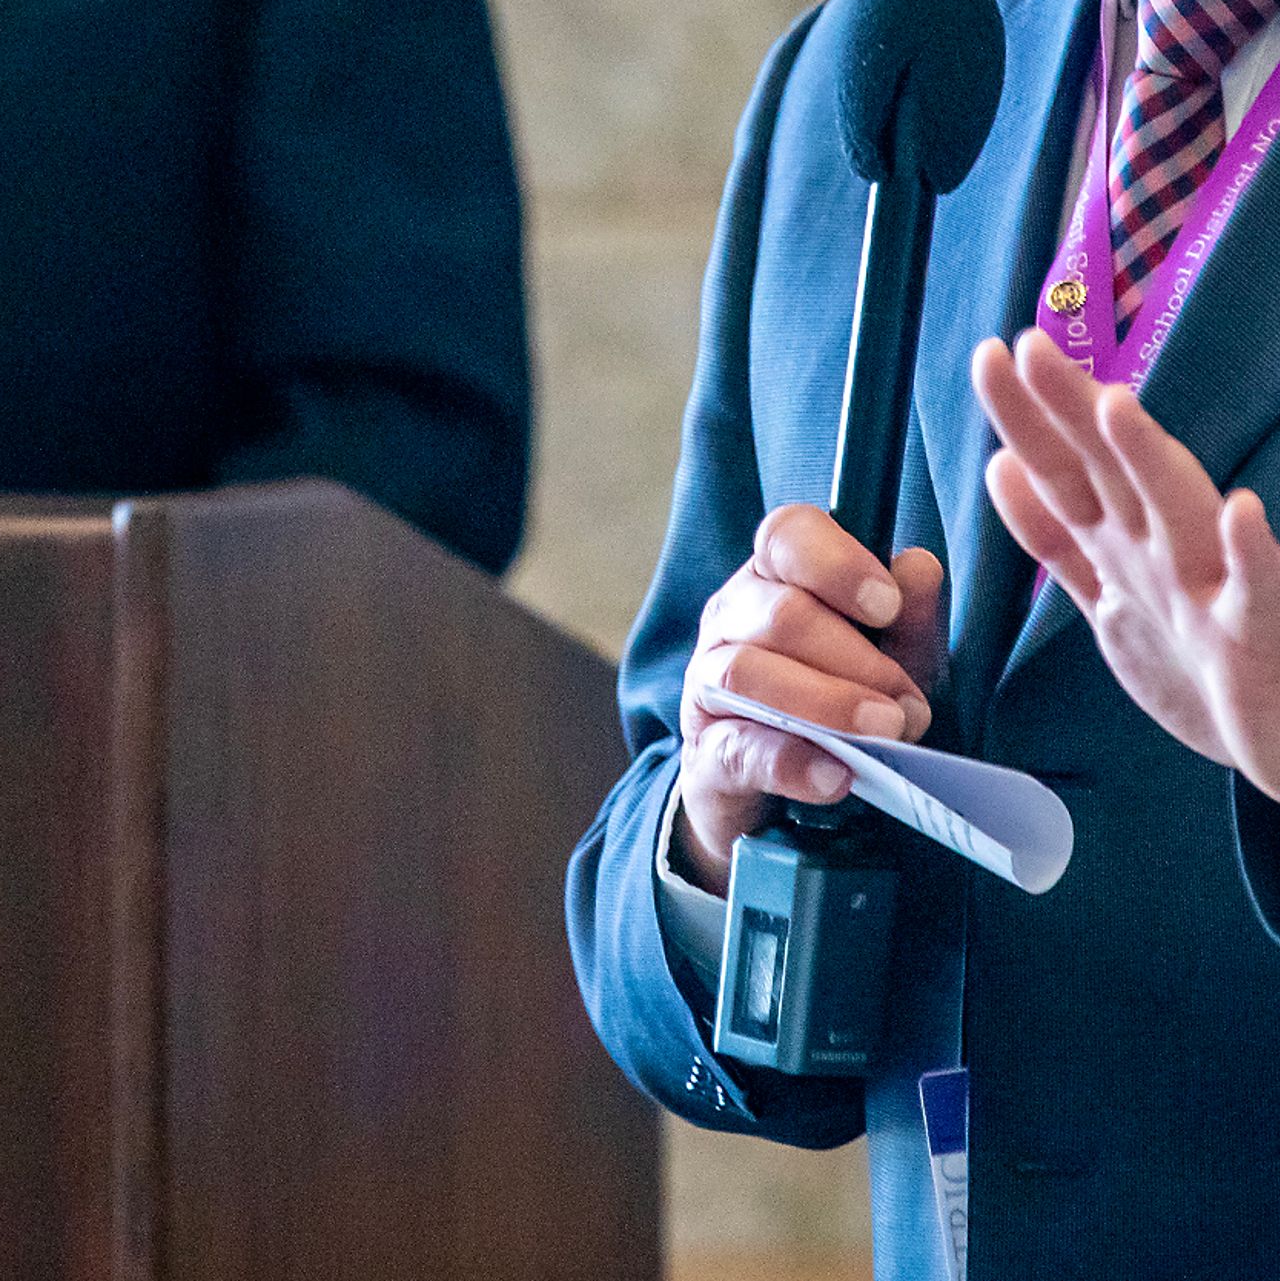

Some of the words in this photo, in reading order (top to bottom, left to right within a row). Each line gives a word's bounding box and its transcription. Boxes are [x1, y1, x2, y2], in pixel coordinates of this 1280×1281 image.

[1066, 251, 1094, 348] Scool
[1138, 266, 1193, 362] School
[1185, 160, 1259, 260] District
